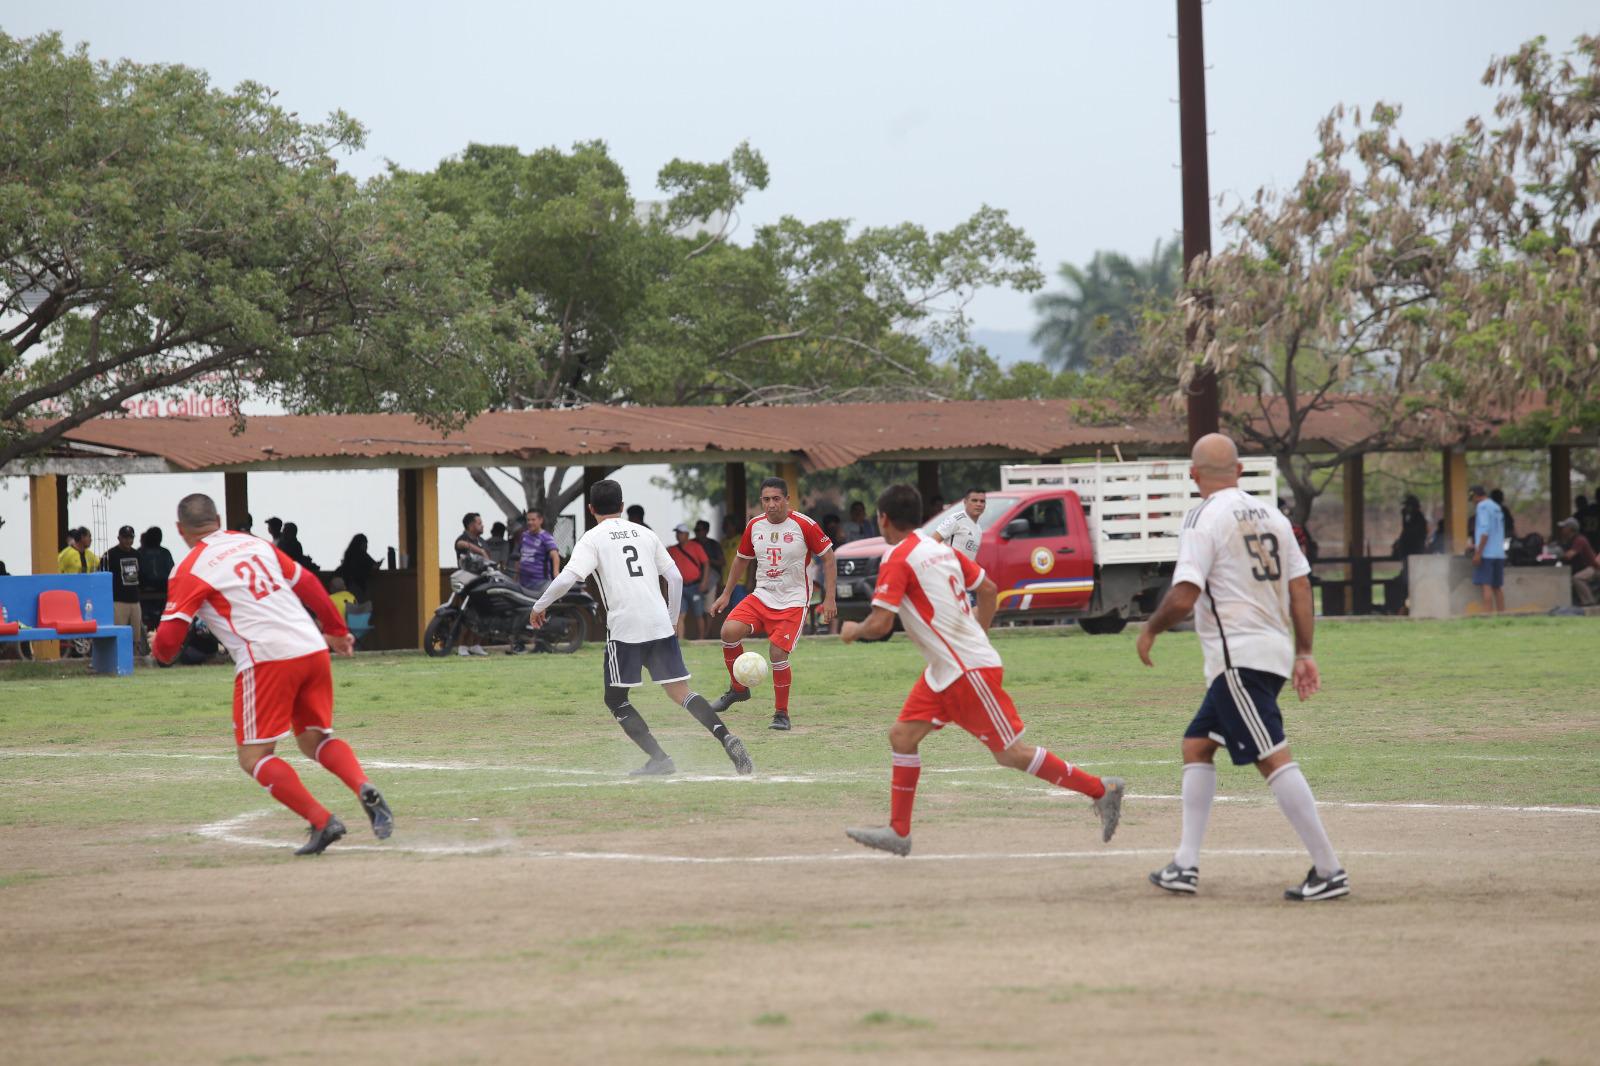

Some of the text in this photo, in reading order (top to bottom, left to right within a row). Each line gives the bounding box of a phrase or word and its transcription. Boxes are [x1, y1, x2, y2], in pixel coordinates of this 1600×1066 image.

[609, 531, 630, 540] JOSE
[622, 545, 644, 577] 2
[1243, 533, 1281, 581] 53
[234, 554, 282, 601] 21
